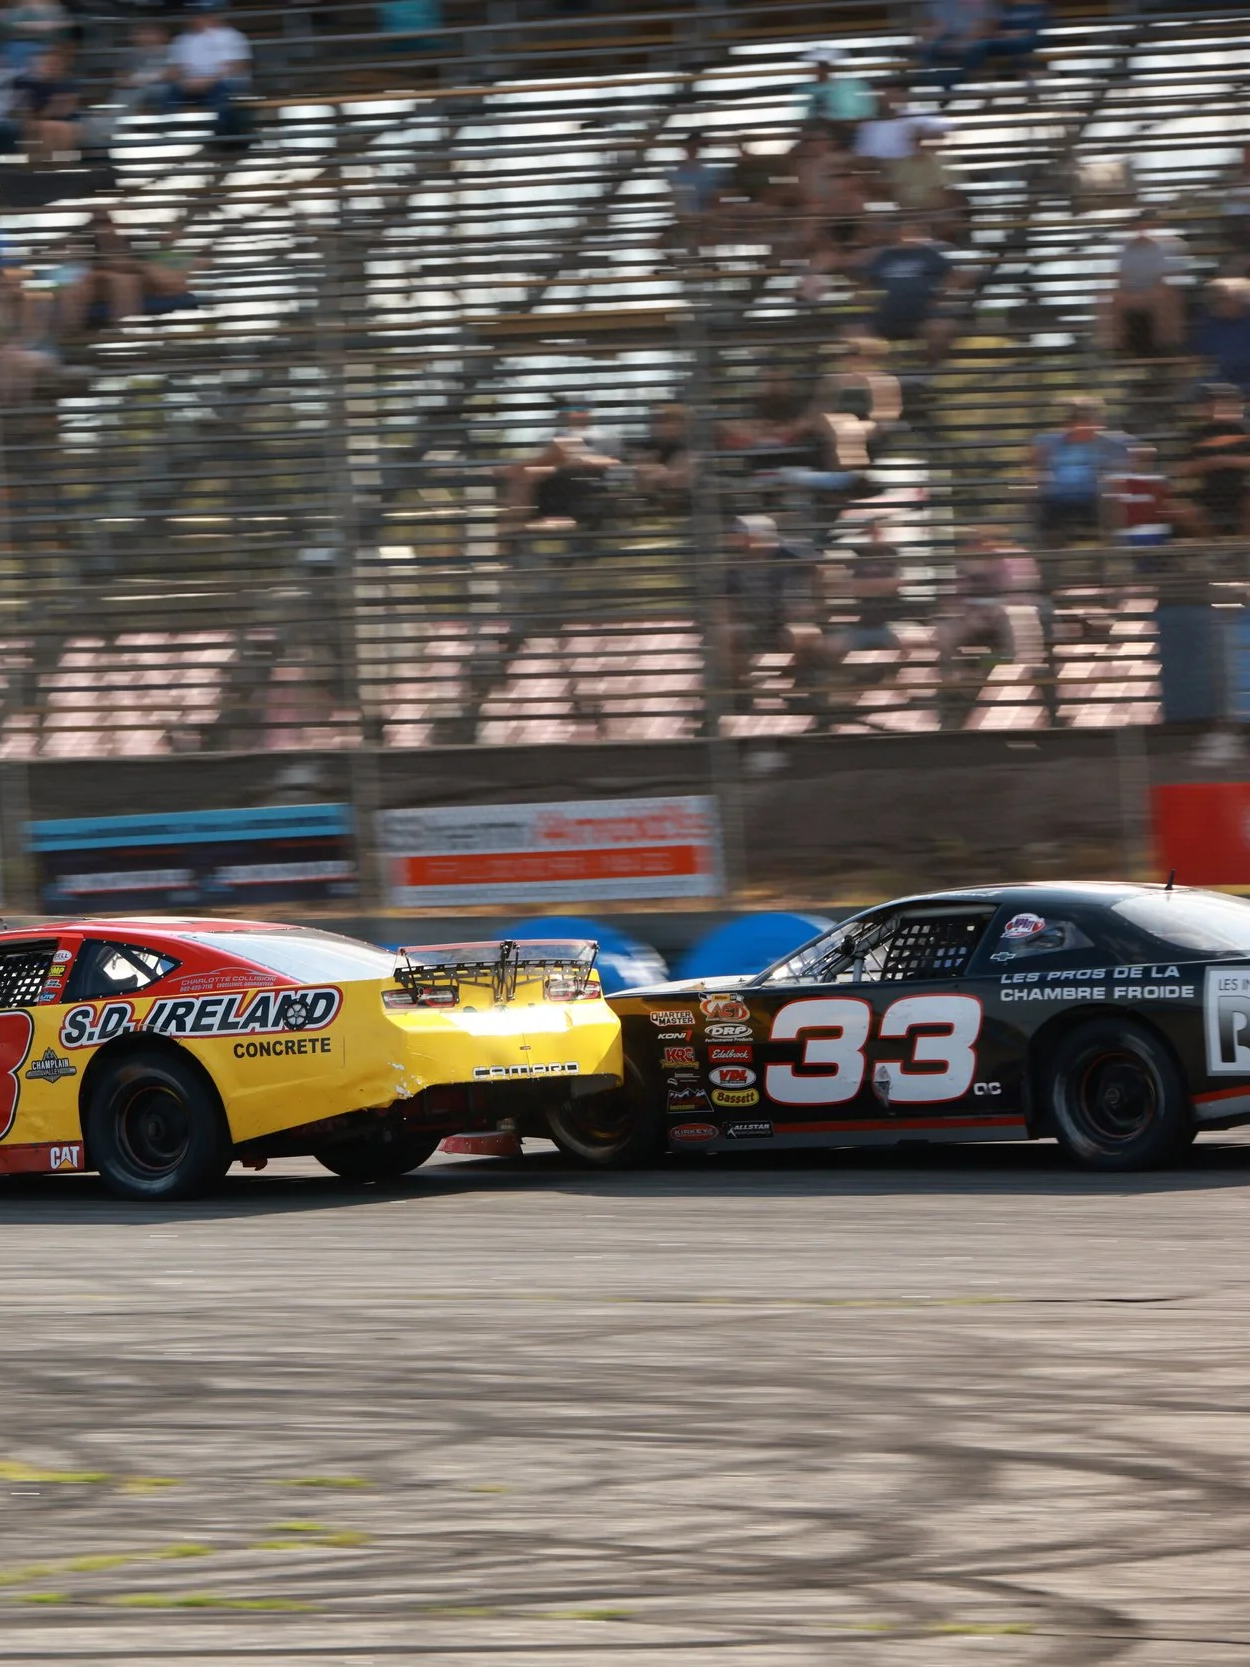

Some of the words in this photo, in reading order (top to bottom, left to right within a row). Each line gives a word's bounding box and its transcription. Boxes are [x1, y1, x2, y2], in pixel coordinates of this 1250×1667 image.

[1001, 972, 1040, 984] LES
[1046, 968, 1107, 981] PROS
[1113, 966, 1143, 979] DE
[1151, 965, 1180, 978] LA
[1218, 978, 1238, 991] LES
[1000, 986, 1106, 1002] CHAMBRE
[1113, 985, 1195, 999] FROIDE
[142, 988, 342, 1035] IRELAND
[651, 1011, 692, 1021] QUARTER
[658, 1017, 694, 1026] MASTER
[657, 1032, 686, 1040] KONI
[711, 1026, 746, 1036] DRP
[233, 1037, 332, 1059] CONCRETE
[711, 1049, 749, 1059] Edelbrock
[764, 993, 983, 1105] 33
[32, 1058, 69, 1071] CHAMPLAIN
[473, 1061, 579, 1079] CAMARO
[717, 1091, 755, 1104] Bassett
[734, 1123, 770, 1131] ALLSTAR
[50, 1146, 80, 1169] CAT
